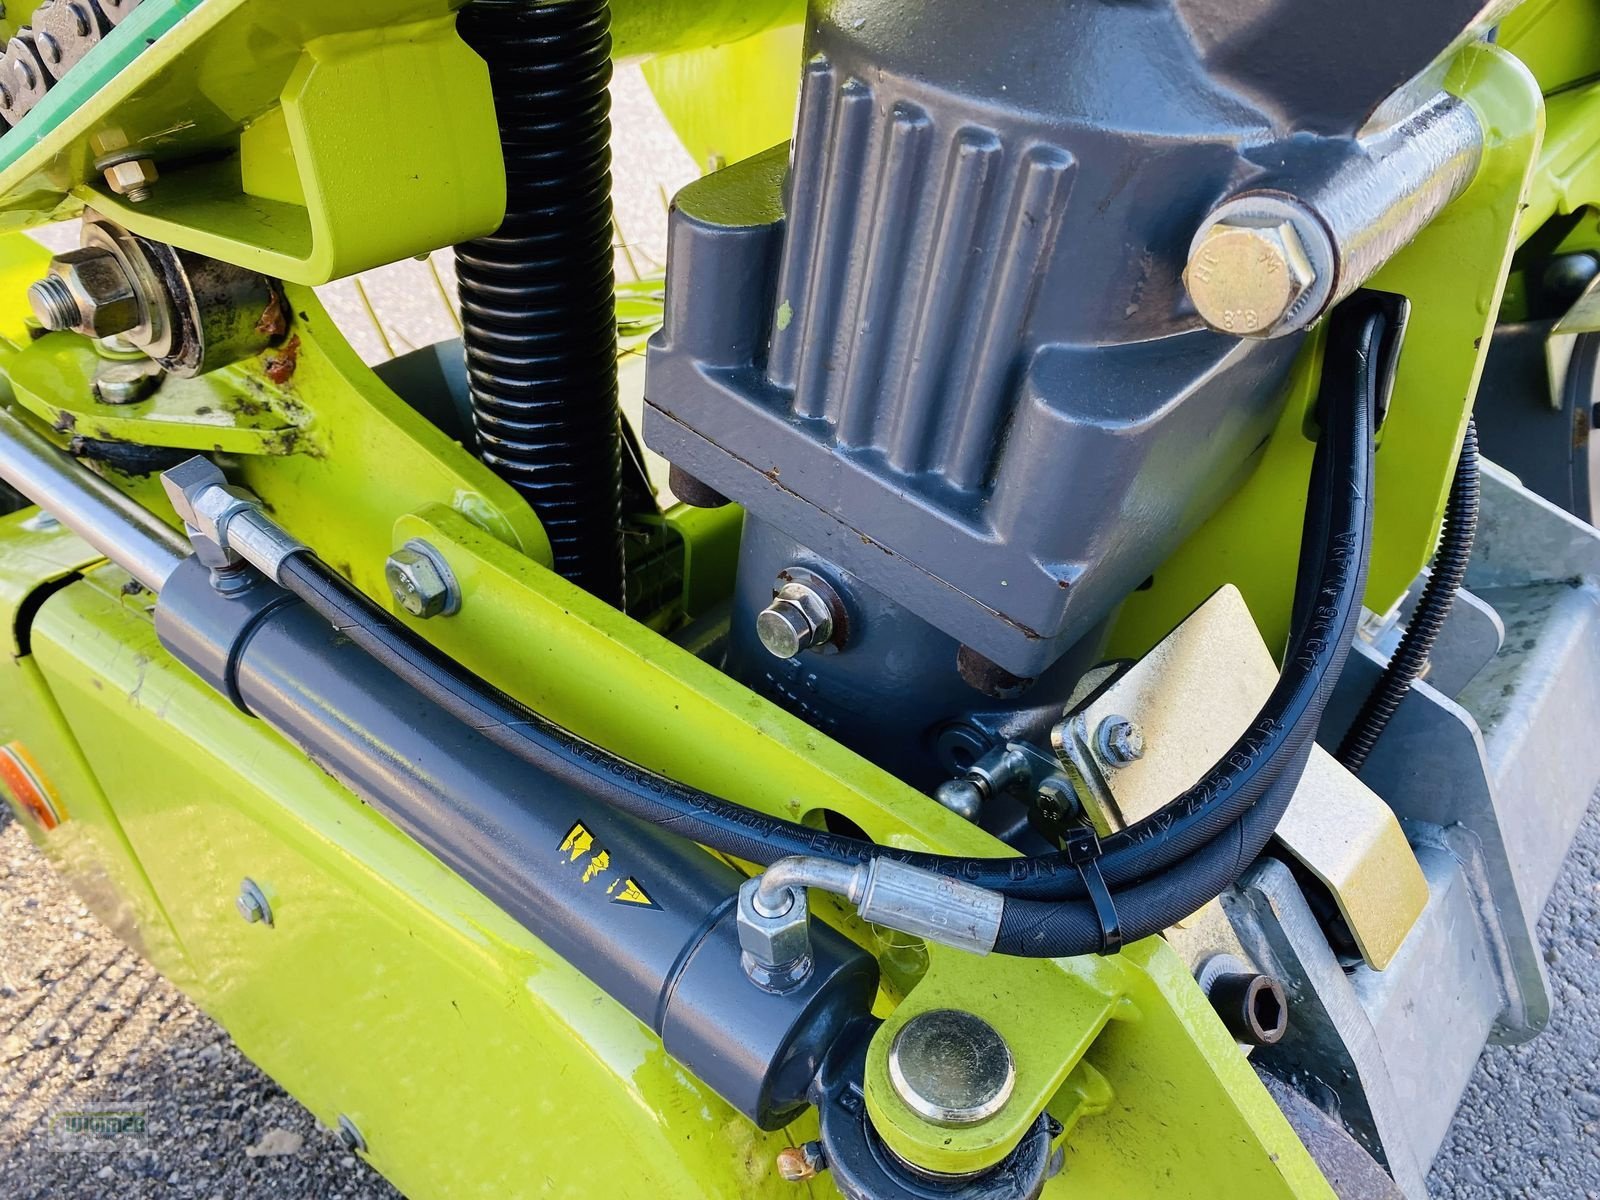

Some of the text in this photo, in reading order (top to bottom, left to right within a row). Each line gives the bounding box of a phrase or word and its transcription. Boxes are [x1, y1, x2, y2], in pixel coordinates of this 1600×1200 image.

[1009, 856, 1058, 881] DN
[1178, 774, 1233, 816] 225
[1229, 717, 1285, 772] BAR
